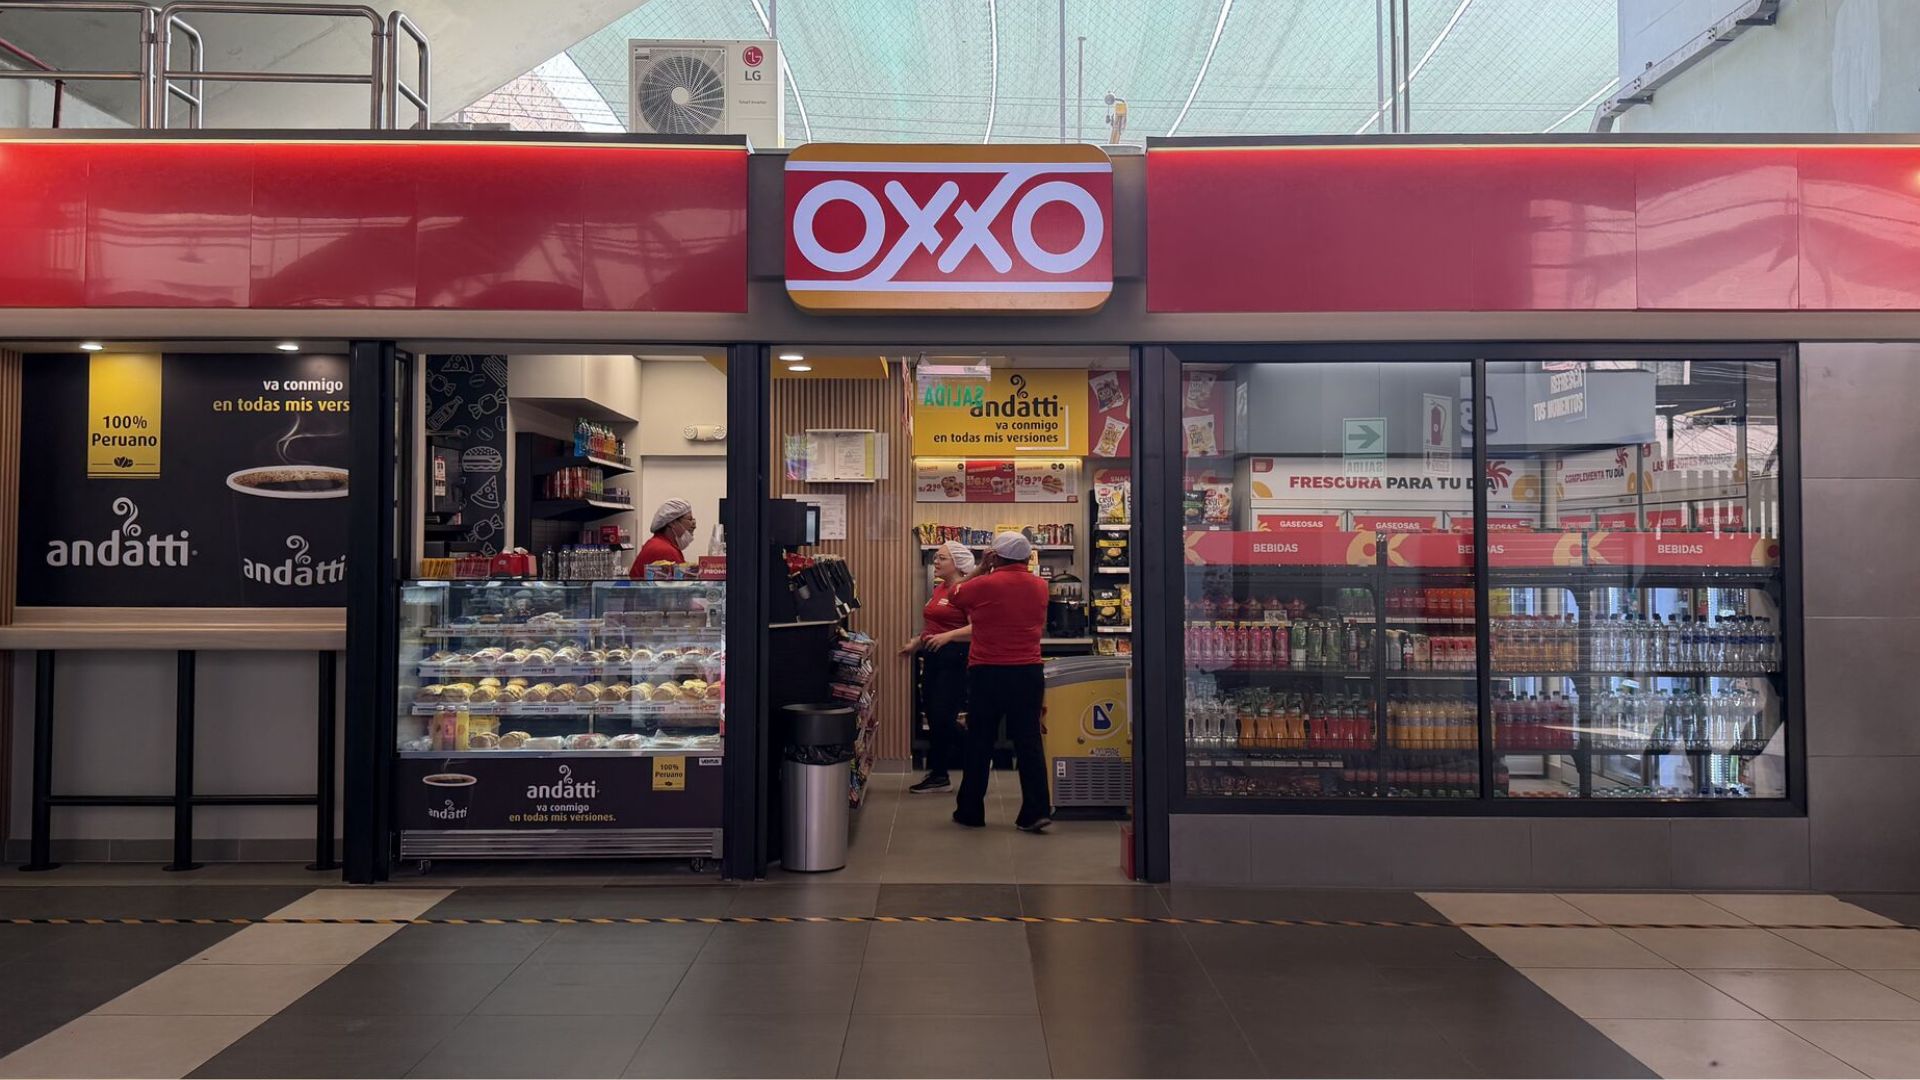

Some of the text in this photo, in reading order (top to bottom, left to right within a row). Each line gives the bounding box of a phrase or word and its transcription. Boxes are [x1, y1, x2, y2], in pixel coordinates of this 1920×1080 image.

[744, 70, 761, 81] LG
[792, 179, 1104, 274] OXXO
[263, 378, 343, 395] va conmigo
[212, 398, 350, 412] en todas mis vers
[970, 395, 1058, 417] andatti
[102, 415, 147, 429] 100%
[996, 421, 1058, 432] va conmigo
[91, 432, 157, 447] Peruano
[933, 433, 1058, 443] en todas mis versiones
[1289, 476, 1382, 489] FRESCURA
[1386, 477, 1432, 489] PARA
[1437, 477, 1461, 489] TU
[1279, 520, 1323, 528] GASEOSAS
[45, 529, 191, 567] andatti
[1253, 544, 1298, 553] BEBIDAS
[1657, 544, 1703, 554] BEBIDAS
[243, 554, 346, 587] andatti
[526, 780, 596, 799] andatti
[428, 807, 468, 819] andatti
[536, 803, 589, 814] va conmigo
[509, 812, 616, 822] en todas mis versiones.
